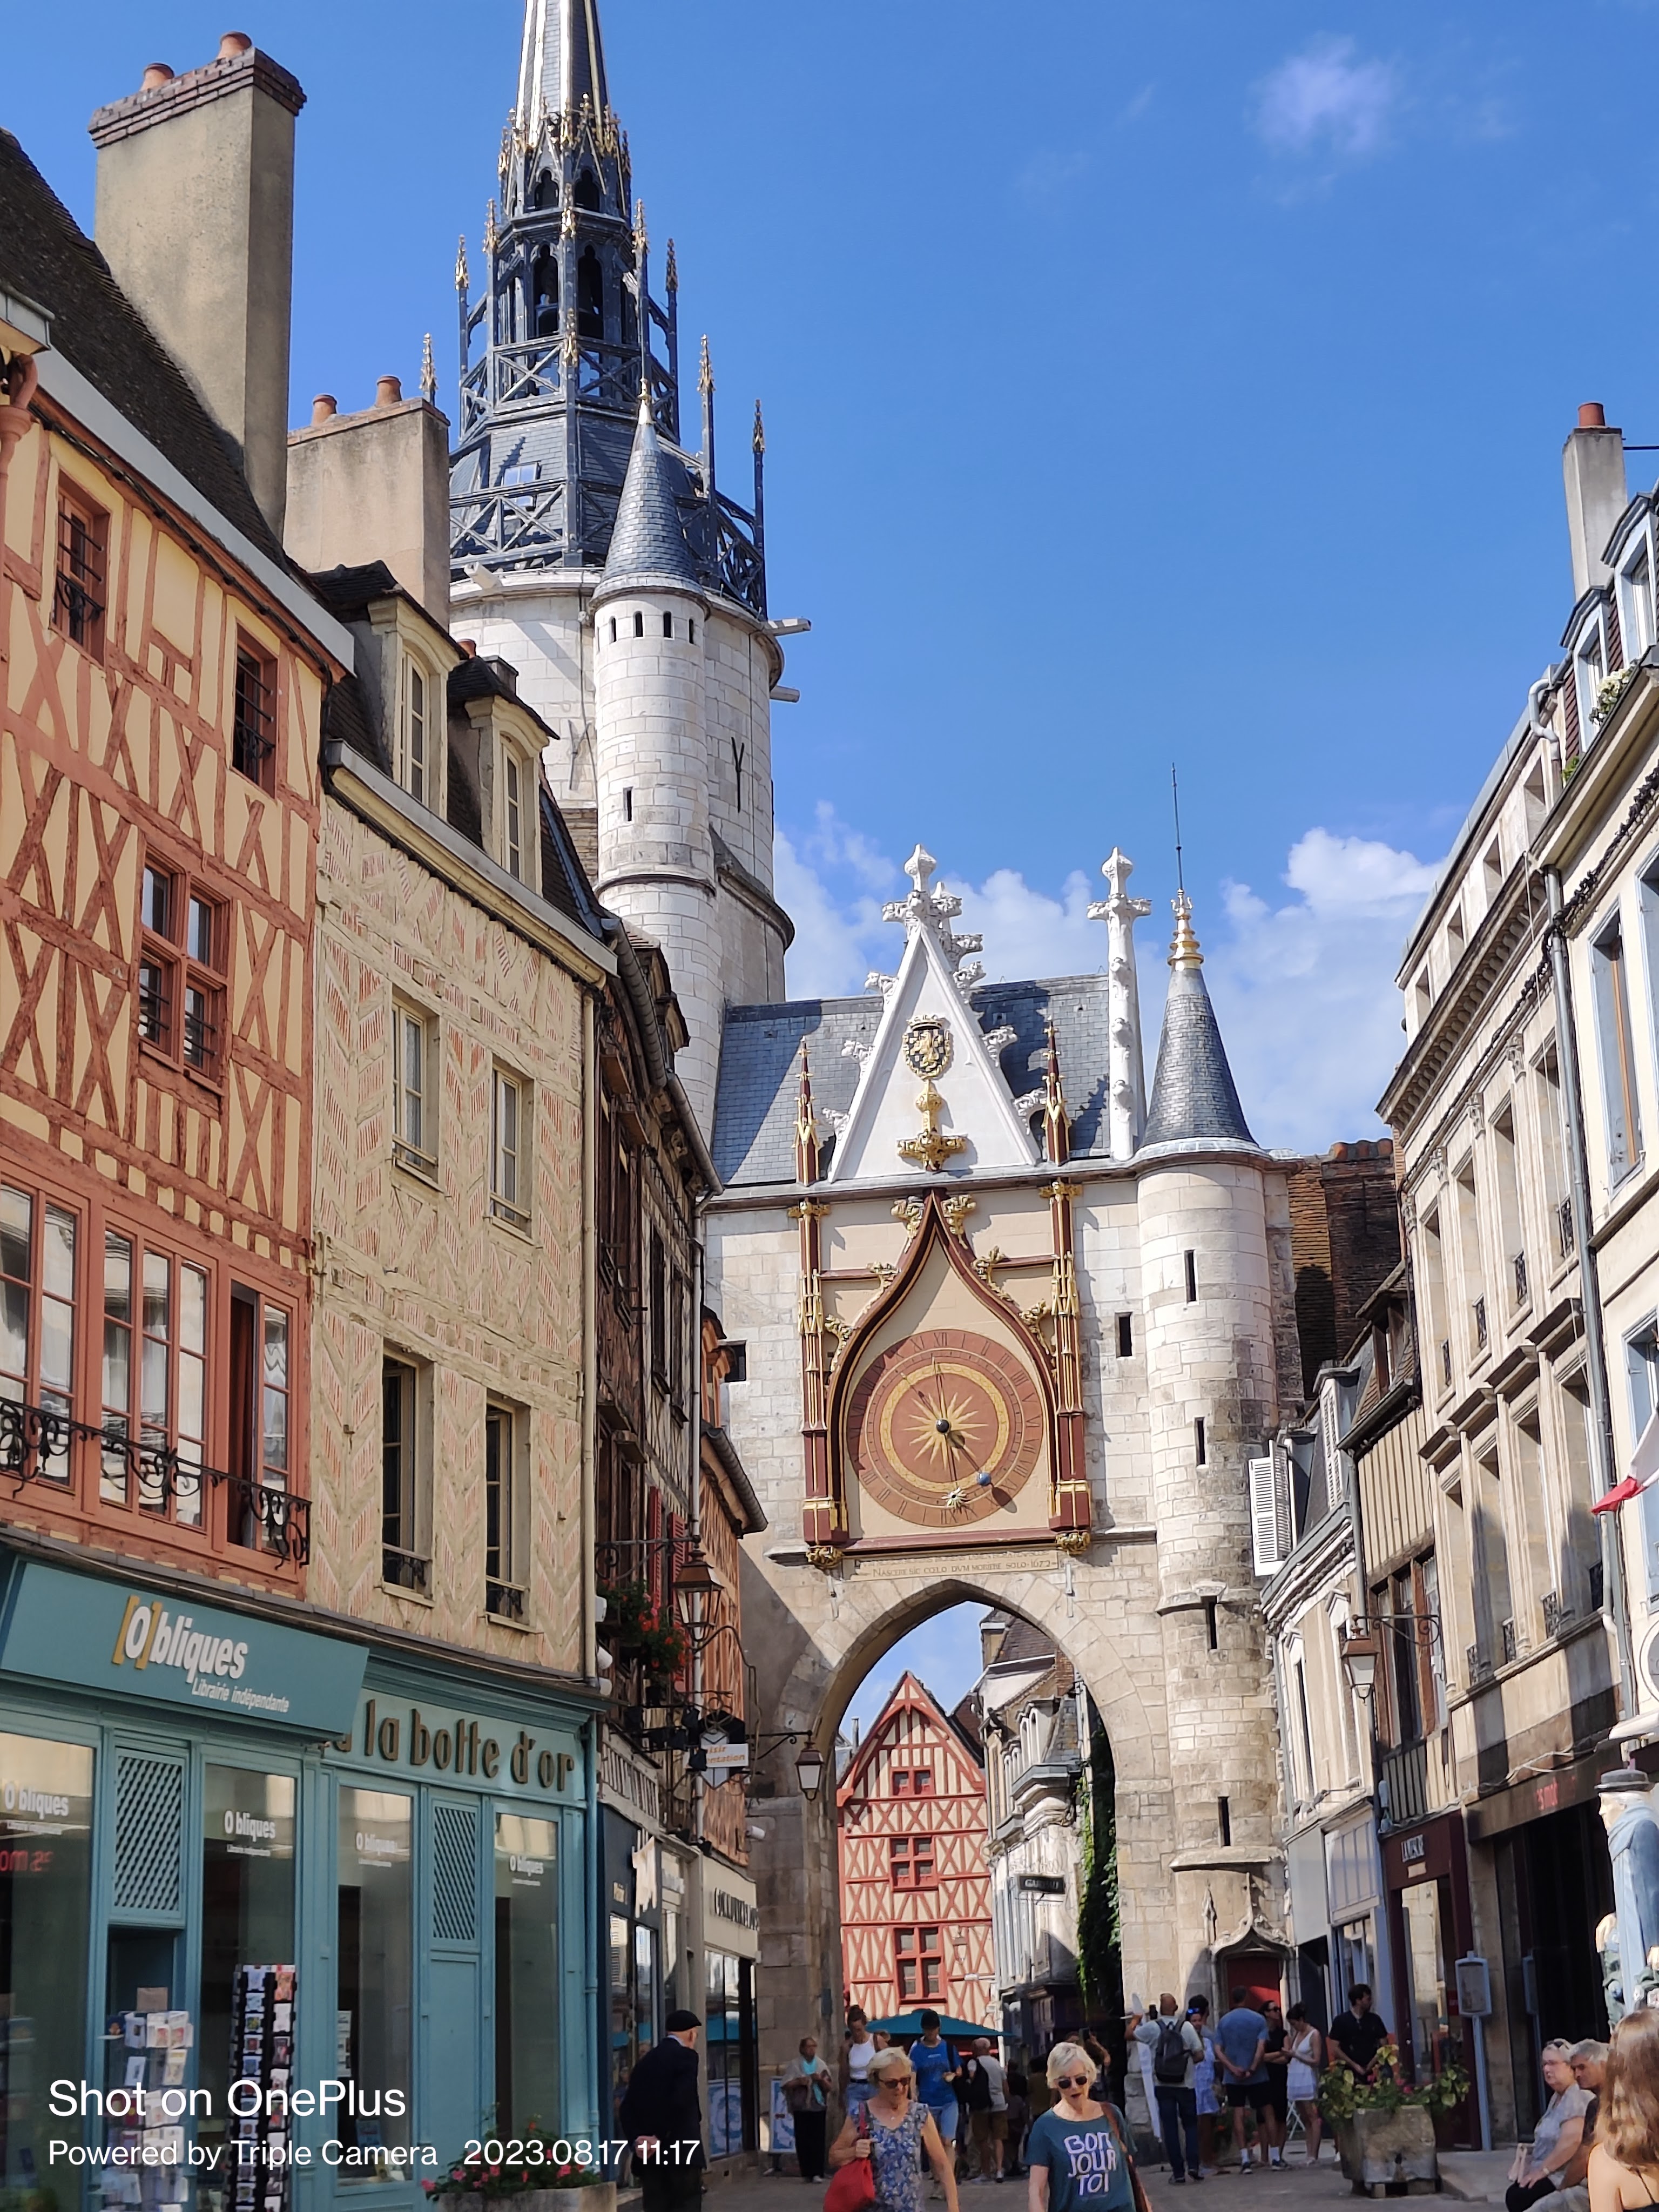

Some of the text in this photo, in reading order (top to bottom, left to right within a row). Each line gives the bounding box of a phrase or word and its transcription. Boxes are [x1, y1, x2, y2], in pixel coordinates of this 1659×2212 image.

[933, 1332, 948, 1347] XII
[998, 1352, 1012, 1369] III
[191, 1677, 290, 1713] Librairie indépendante
[364, 1699, 575, 1792] la botte d'or
[1076, 2170, 1109, 2196] TOI
